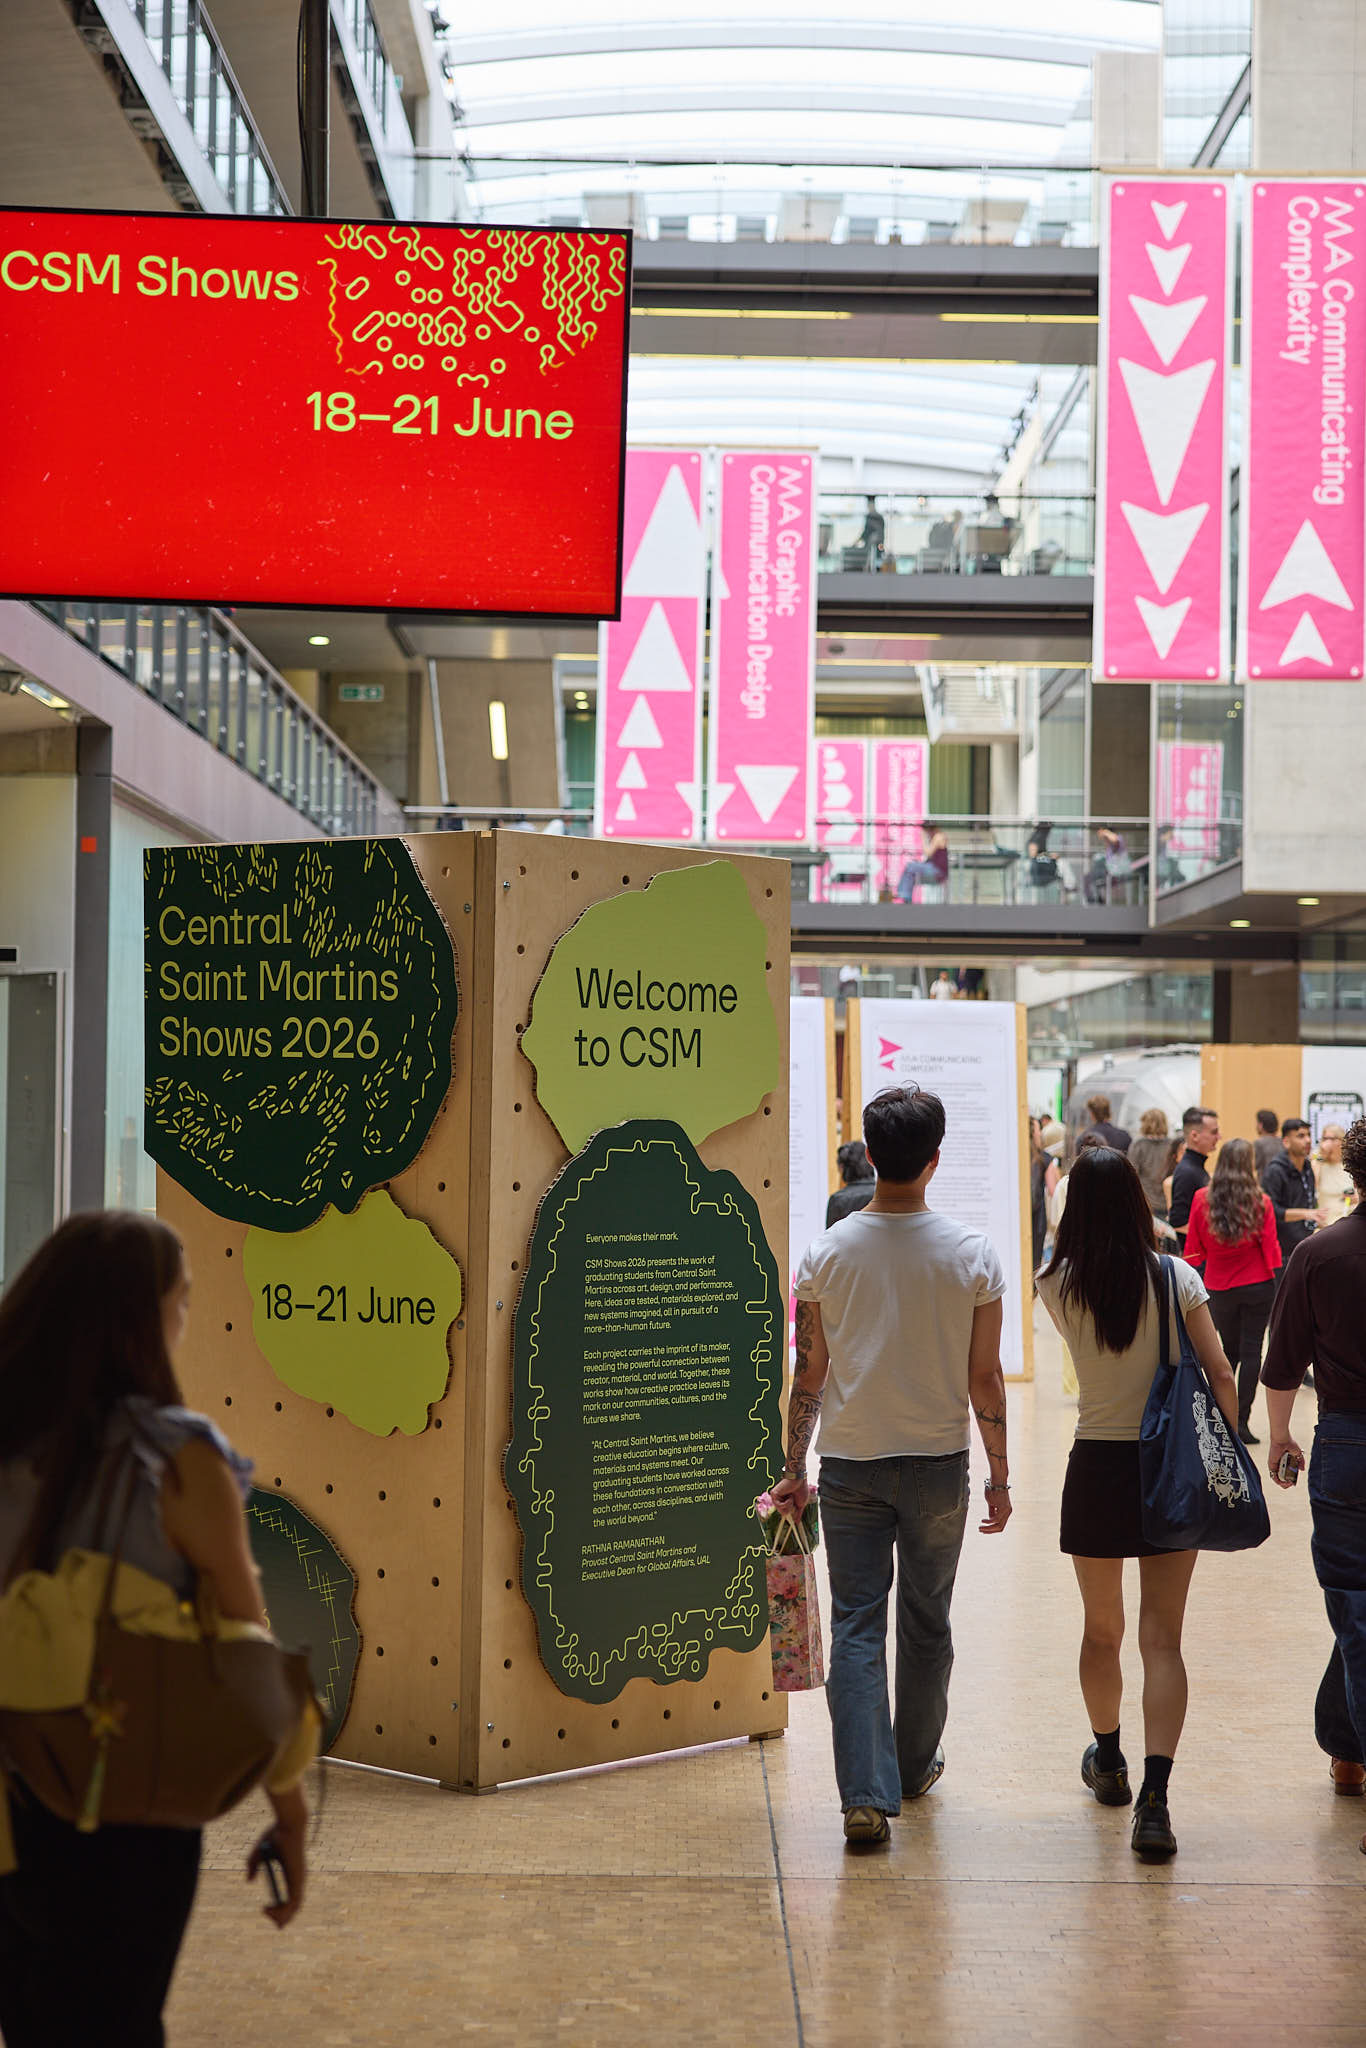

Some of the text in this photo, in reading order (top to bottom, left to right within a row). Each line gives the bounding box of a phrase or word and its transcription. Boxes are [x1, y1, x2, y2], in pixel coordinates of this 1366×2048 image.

[1, 250, 300, 302] CSM Shows
[1279, 195, 1320, 366] Complexity
[1313, 195, 1355, 506] MA Communicating
[453, 396, 574, 440] June
[774, 464, 803, 617] MA Graphic
[739, 464, 776, 719] Communication Design
[158, 904, 292, 946] Central
[158, 960, 399, 1003] Saint Martins
[575, 967, 738, 1013] Welcome
[159, 1016, 380, 1060] Shows 2026
[574, 1026, 702, 1068] to CSM
[586, 1233, 618, 1245] Everyone
[619, 1232, 641, 1242] makes
[643, 1232, 659, 1241] their
[585, 1255, 715, 1269] CSM Shows 2026 presents the work of
[584, 1268, 716, 1284] graduating students from Central Saint
[584, 1285, 611, 1295] Martins
[674, 1281, 688, 1291] and
[357, 1285, 436, 1326] June
[604, 1297, 622, 1307] ideas
[624, 1298, 635, 1306] are
[661, 1294, 693, 1304] materials
[725, 1291, 738, 1301] and
[584, 1313, 599, 1321] new
[600, 1309, 628, 1322] systems
[663, 1307, 672, 1316] all
[673, 1307, 680, 1316] in
[681, 1305, 704, 1318] pursuit
[705, 1305, 713, 1314] of
[584, 1321, 648, 1333] more-than-human
[584, 1350, 601, 1360] Each
[602, 1348, 627, 1361] project
[628, 1346, 652, 1357] carries
[653, 1345, 664, 1355] the
[666, 1344, 690, 1356] imprint
[690, 1343, 698, 1353] of
[699, 1343, 707, 1352] its
[583, 1354, 729, 1375] revealing the powerful connection between
[643, 1371, 656, 1381] and
[711, 1366, 730, 1376] these
[583, 1378, 730, 1398] works show how creative practice leaves its
[583, 1401, 601, 1411] mark
[602, 1402, 612, 1410] on
[612, 1401, 624, 1409] our
[702, 1392, 715, 1402] and
[716, 1391, 727, 1400] the
[583, 1413, 608, 1424] futures
[609, 1414, 619, 1422] we
[603, 1437, 629, 1448] Central
[630, 1435, 649, 1446] Saint
[690, 1429, 714, 1440] believe
[593, 1451, 621, 1462] creative
[622, 1447, 657, 1459] education
[658, 1445, 681, 1458] begins
[682, 1443, 703, 1454] where
[593, 1463, 626, 1475] materials
[627, 1462, 640, 1472] and
[641, 1459, 669, 1473] systems
[691, 1455, 704, 1465] Our
[592, 1467, 729, 1491] graduating students have worked across
[593, 1478, 723, 1501] these foundations in conversation with
[592, 1503, 610, 1514] each
[632, 1500, 655, 1510] across
[694, 1492, 708, 1503] and
[708, 1491, 723, 1501] with
[593, 1517, 605, 1527] the
[606, 1514, 626, 1525] world
[581, 1535, 665, 1554] RATHNA RAMANATHAN
[581, 1544, 697, 1568] Provost Central Saint Martins and
[581, 1568, 615, 1581] Executive
[616, 1565, 635, 1576] Dean
[636, 1563, 646, 1574] for
[648, 1560, 670, 1572] Global
[697, 1555, 710, 1565] UAL
